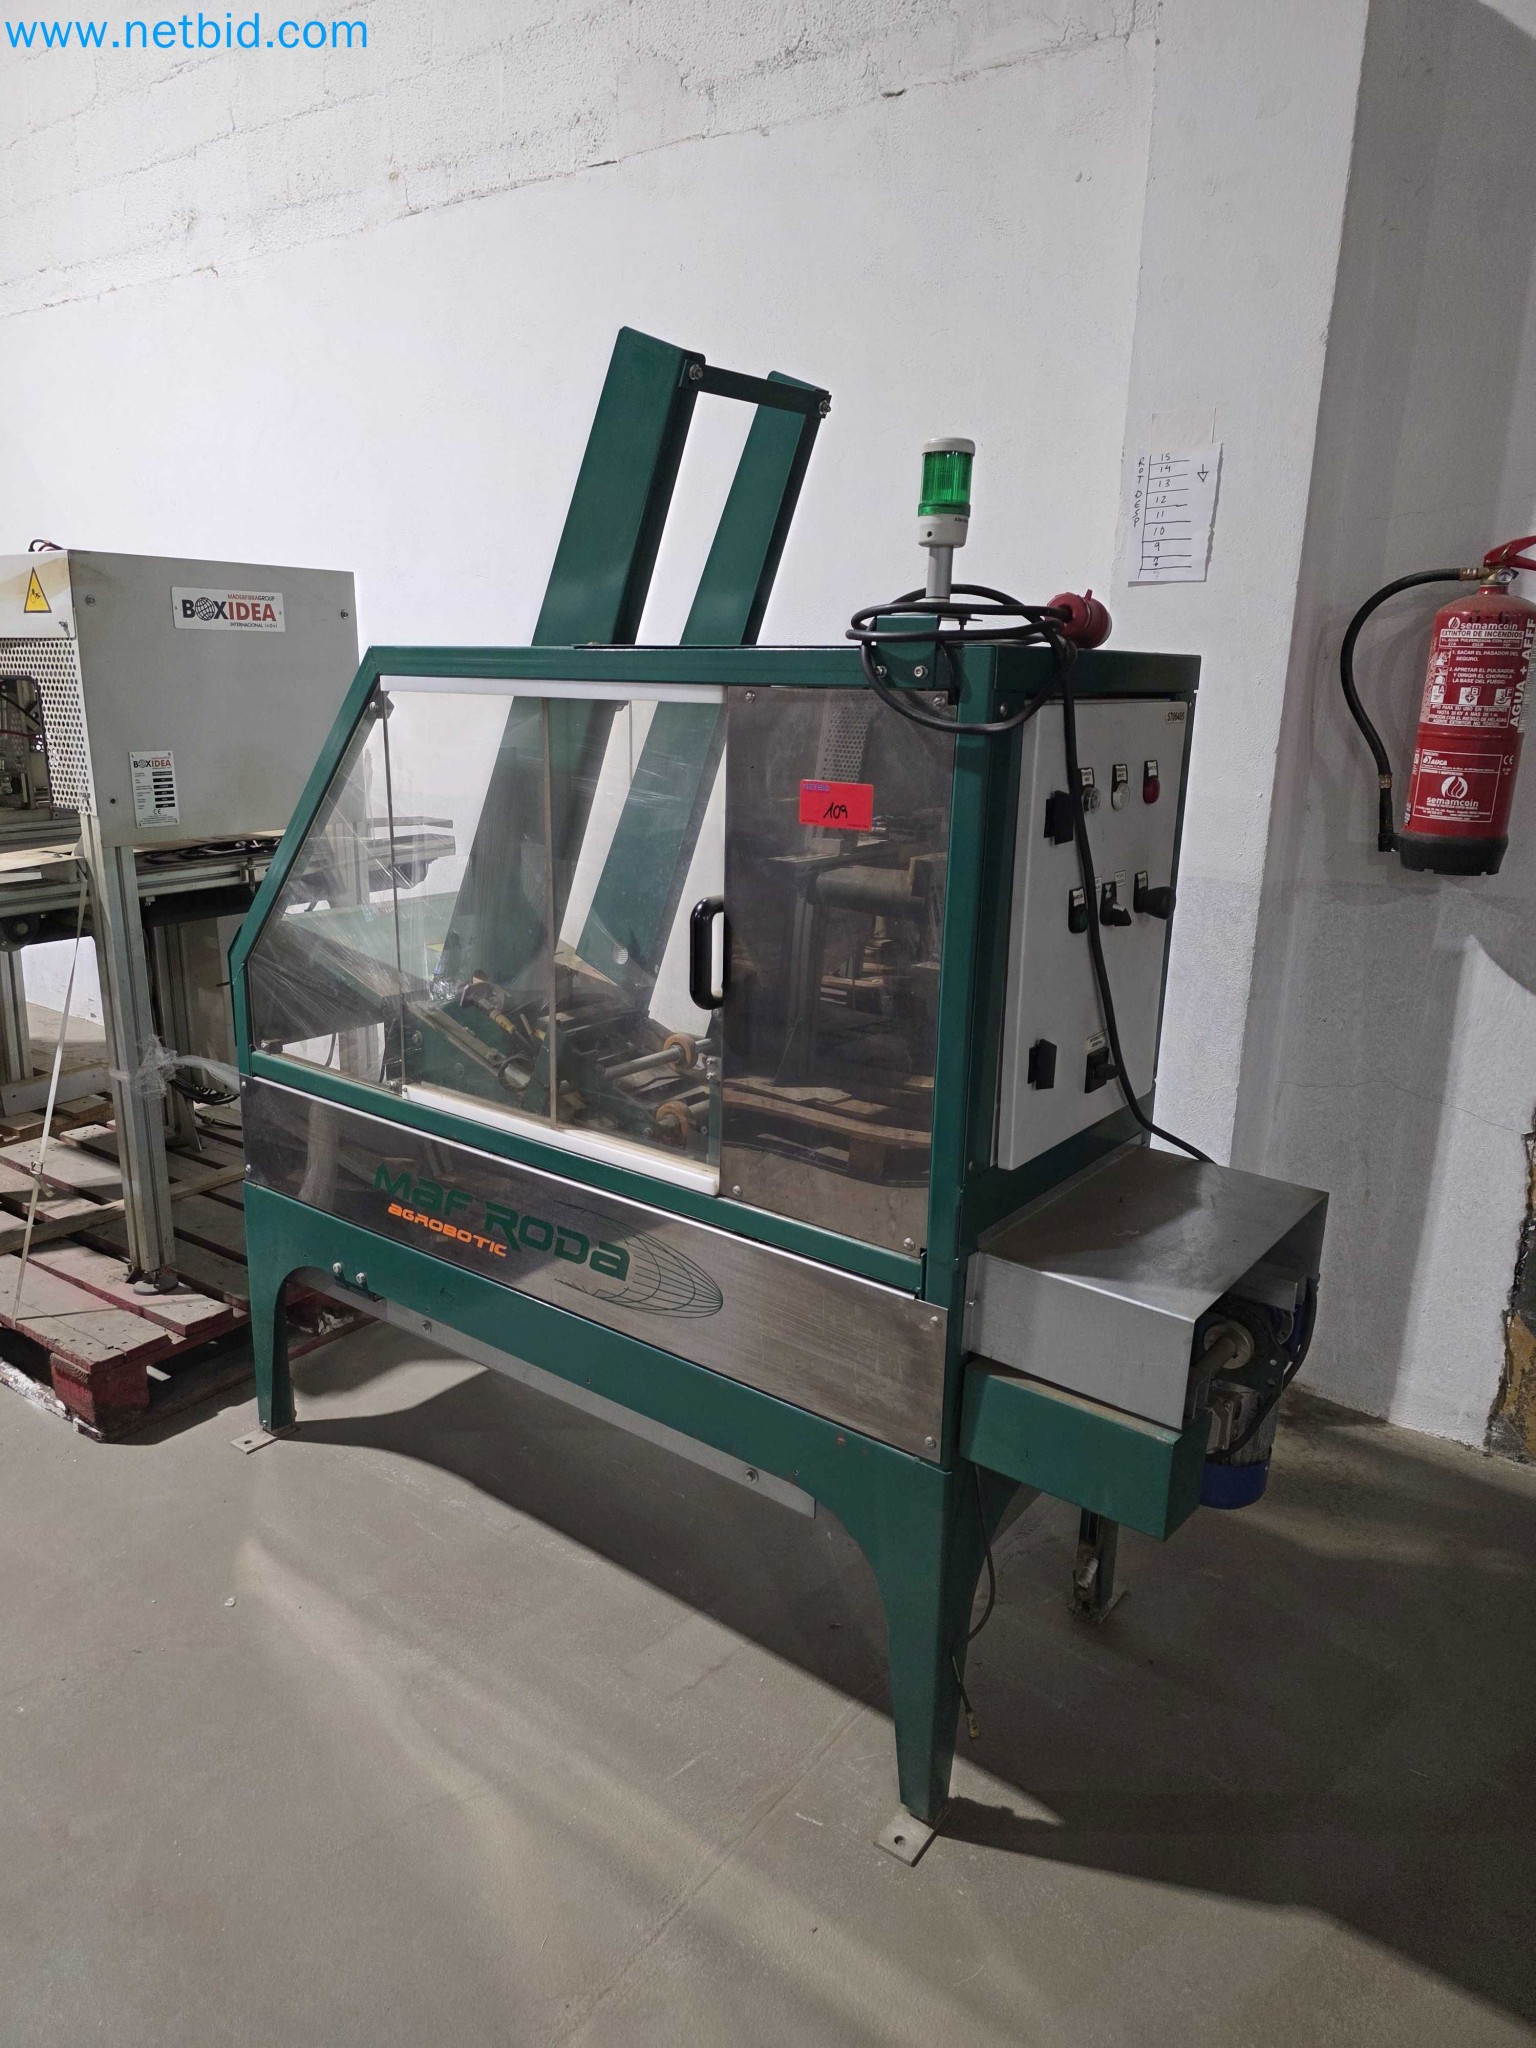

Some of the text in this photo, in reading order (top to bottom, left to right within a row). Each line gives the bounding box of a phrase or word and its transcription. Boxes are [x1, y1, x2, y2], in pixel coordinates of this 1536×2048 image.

[1161, 453, 1171, 461] 15
[1160, 464, 1171, 473] 14
[1158, 478, 1170, 488] 13
[1156, 495, 1167, 504] 12
[1156, 510, 1164, 518] 11
[1153, 526, 1165, 536] 10
[1154, 541, 1160, 551] 9
[1460, 622, 1518, 630] semamcoin
[1441, 629, 1472, 637] EXTINTOR
[1484, 630, 1523, 638] INCENDIOS
[1510, 680, 1526, 728] AGUA
[1521, 618, 1536, 660] AFFF
[1439, 685, 1445, 694] A
[1471, 687, 1479, 695] B
[1426, 797, 1479, 806] semamcoin
[823, 801, 848, 819] 109
